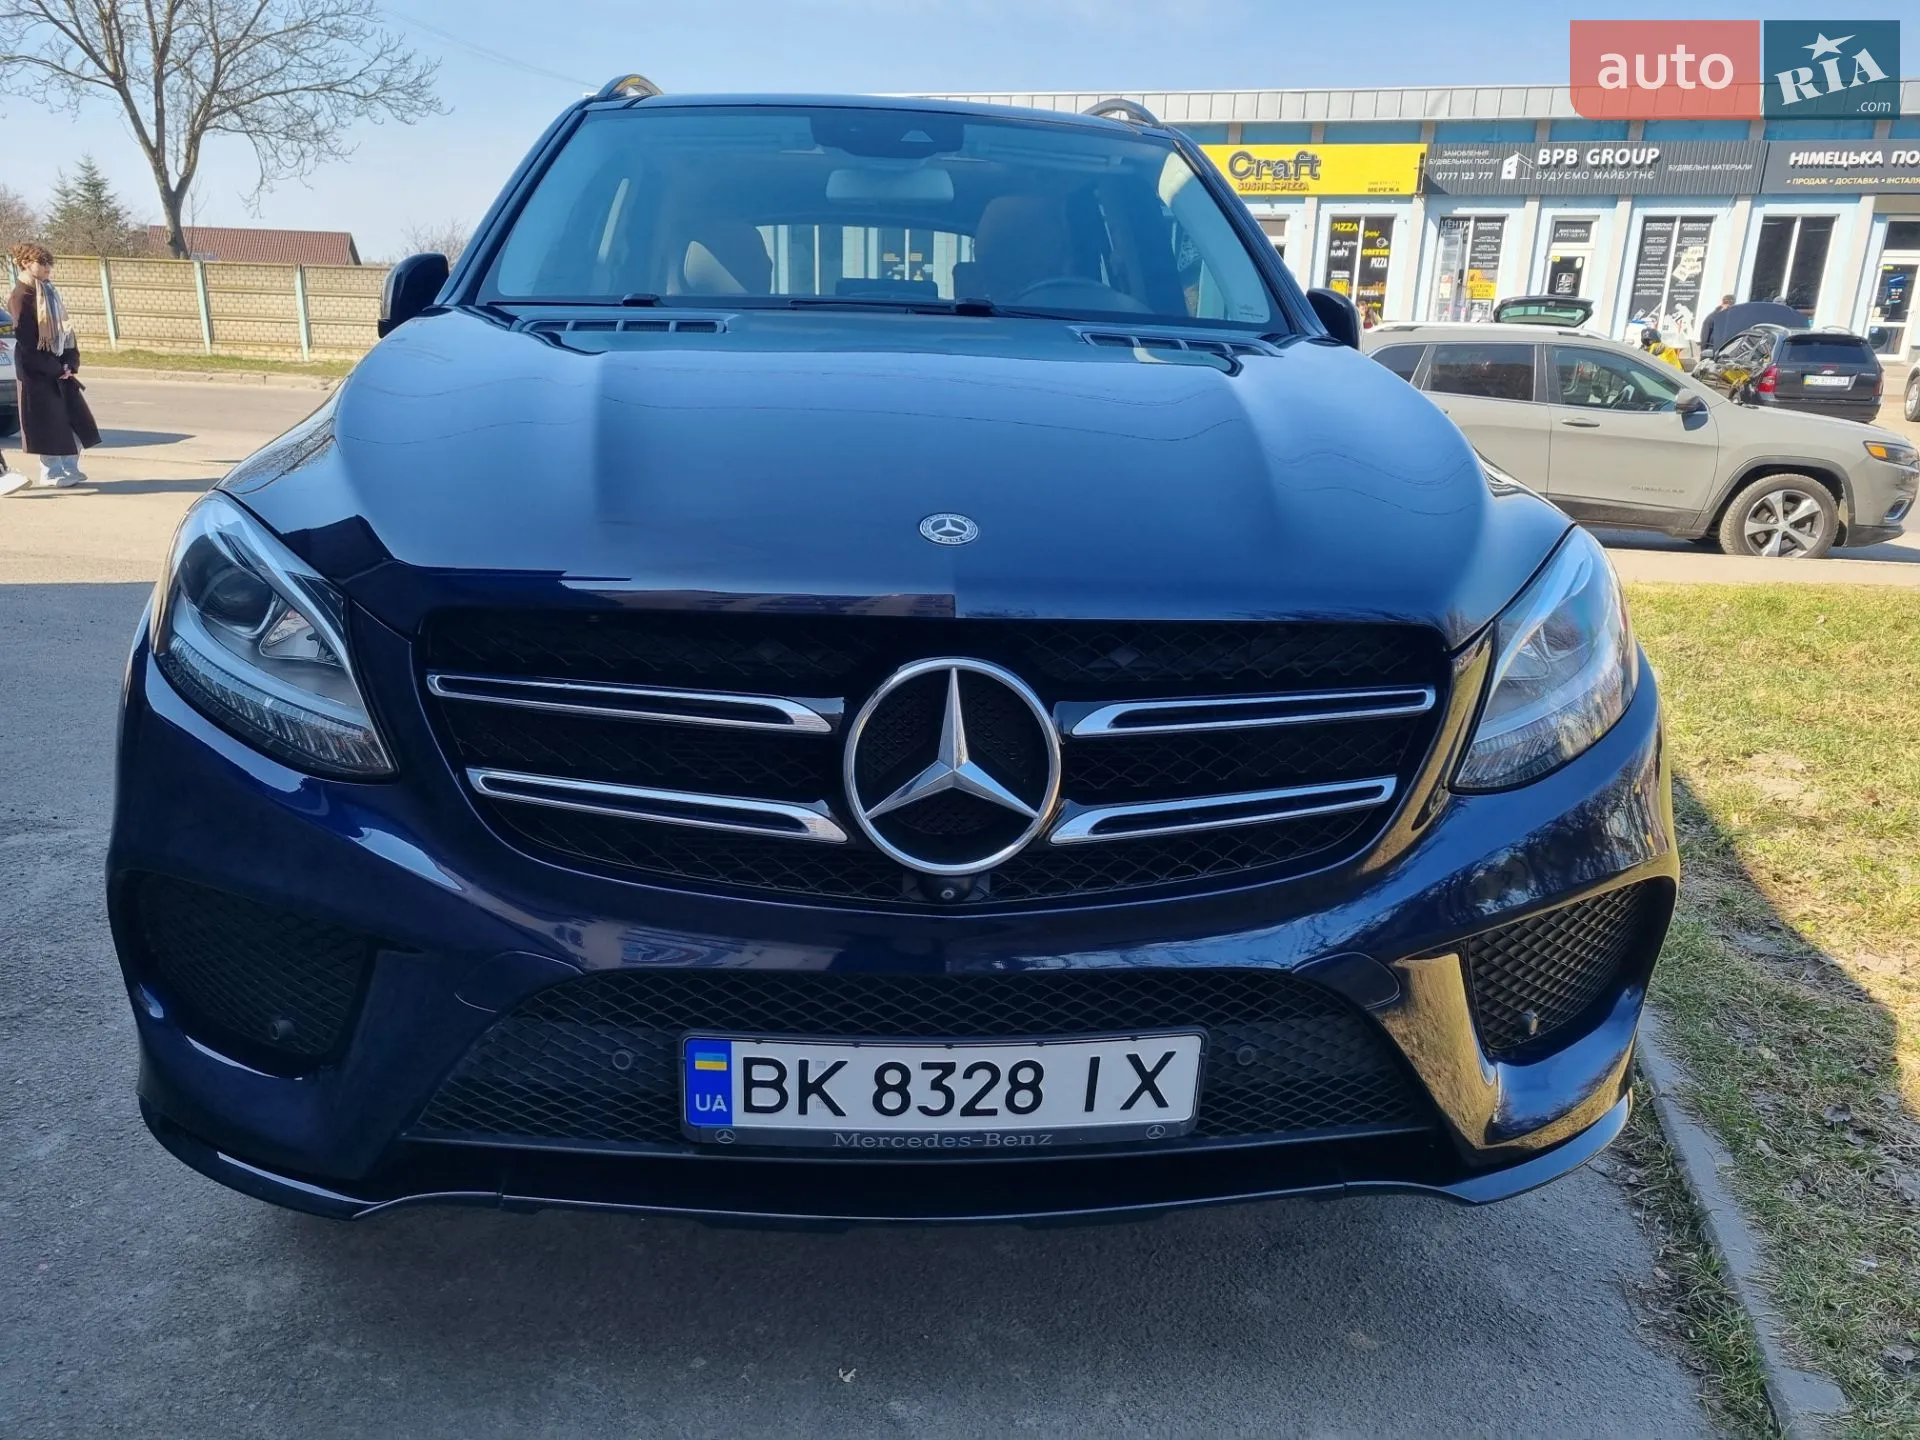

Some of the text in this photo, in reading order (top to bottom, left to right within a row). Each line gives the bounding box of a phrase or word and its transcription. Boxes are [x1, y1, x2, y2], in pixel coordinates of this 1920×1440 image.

[1442, 149, 1490, 158] ЗАМОВЛЕННЯ
[1537, 148, 1660, 167] BPB GROUP
[1228, 150, 1321, 180] Craft
[1428, 157, 1503, 167] БУДІВЕЛЬНИХ ПОСЛУГ
[1789, 150, 1920, 169] НІМЕЦЬКА ПО
[1668, 163, 1753, 173] БУДІВЕЛЬНІ МАТЕРІАЛИ
[1436, 172, 1494, 180] 0777 123 777
[1536, 169, 1656, 182] БУДУЄМО МАЙБУТНЄ
[1792, 177, 1828, 186] ПРОДАЖ
[1835, 176, 1880, 186] ДОСТАВКА
[1280, 181, 1310, 192] PIZZA
[1331, 222, 1359, 233] PIZZA
[1441, 220, 1470, 230] ЦЕНТР
[1370, 257, 1388, 269] PIZZA
[742, 1050, 1177, 1118] BK 8328 IX
[695, 1093, 728, 1113] UA
[832, 1132, 1054, 1150] Mercedes-Benz
